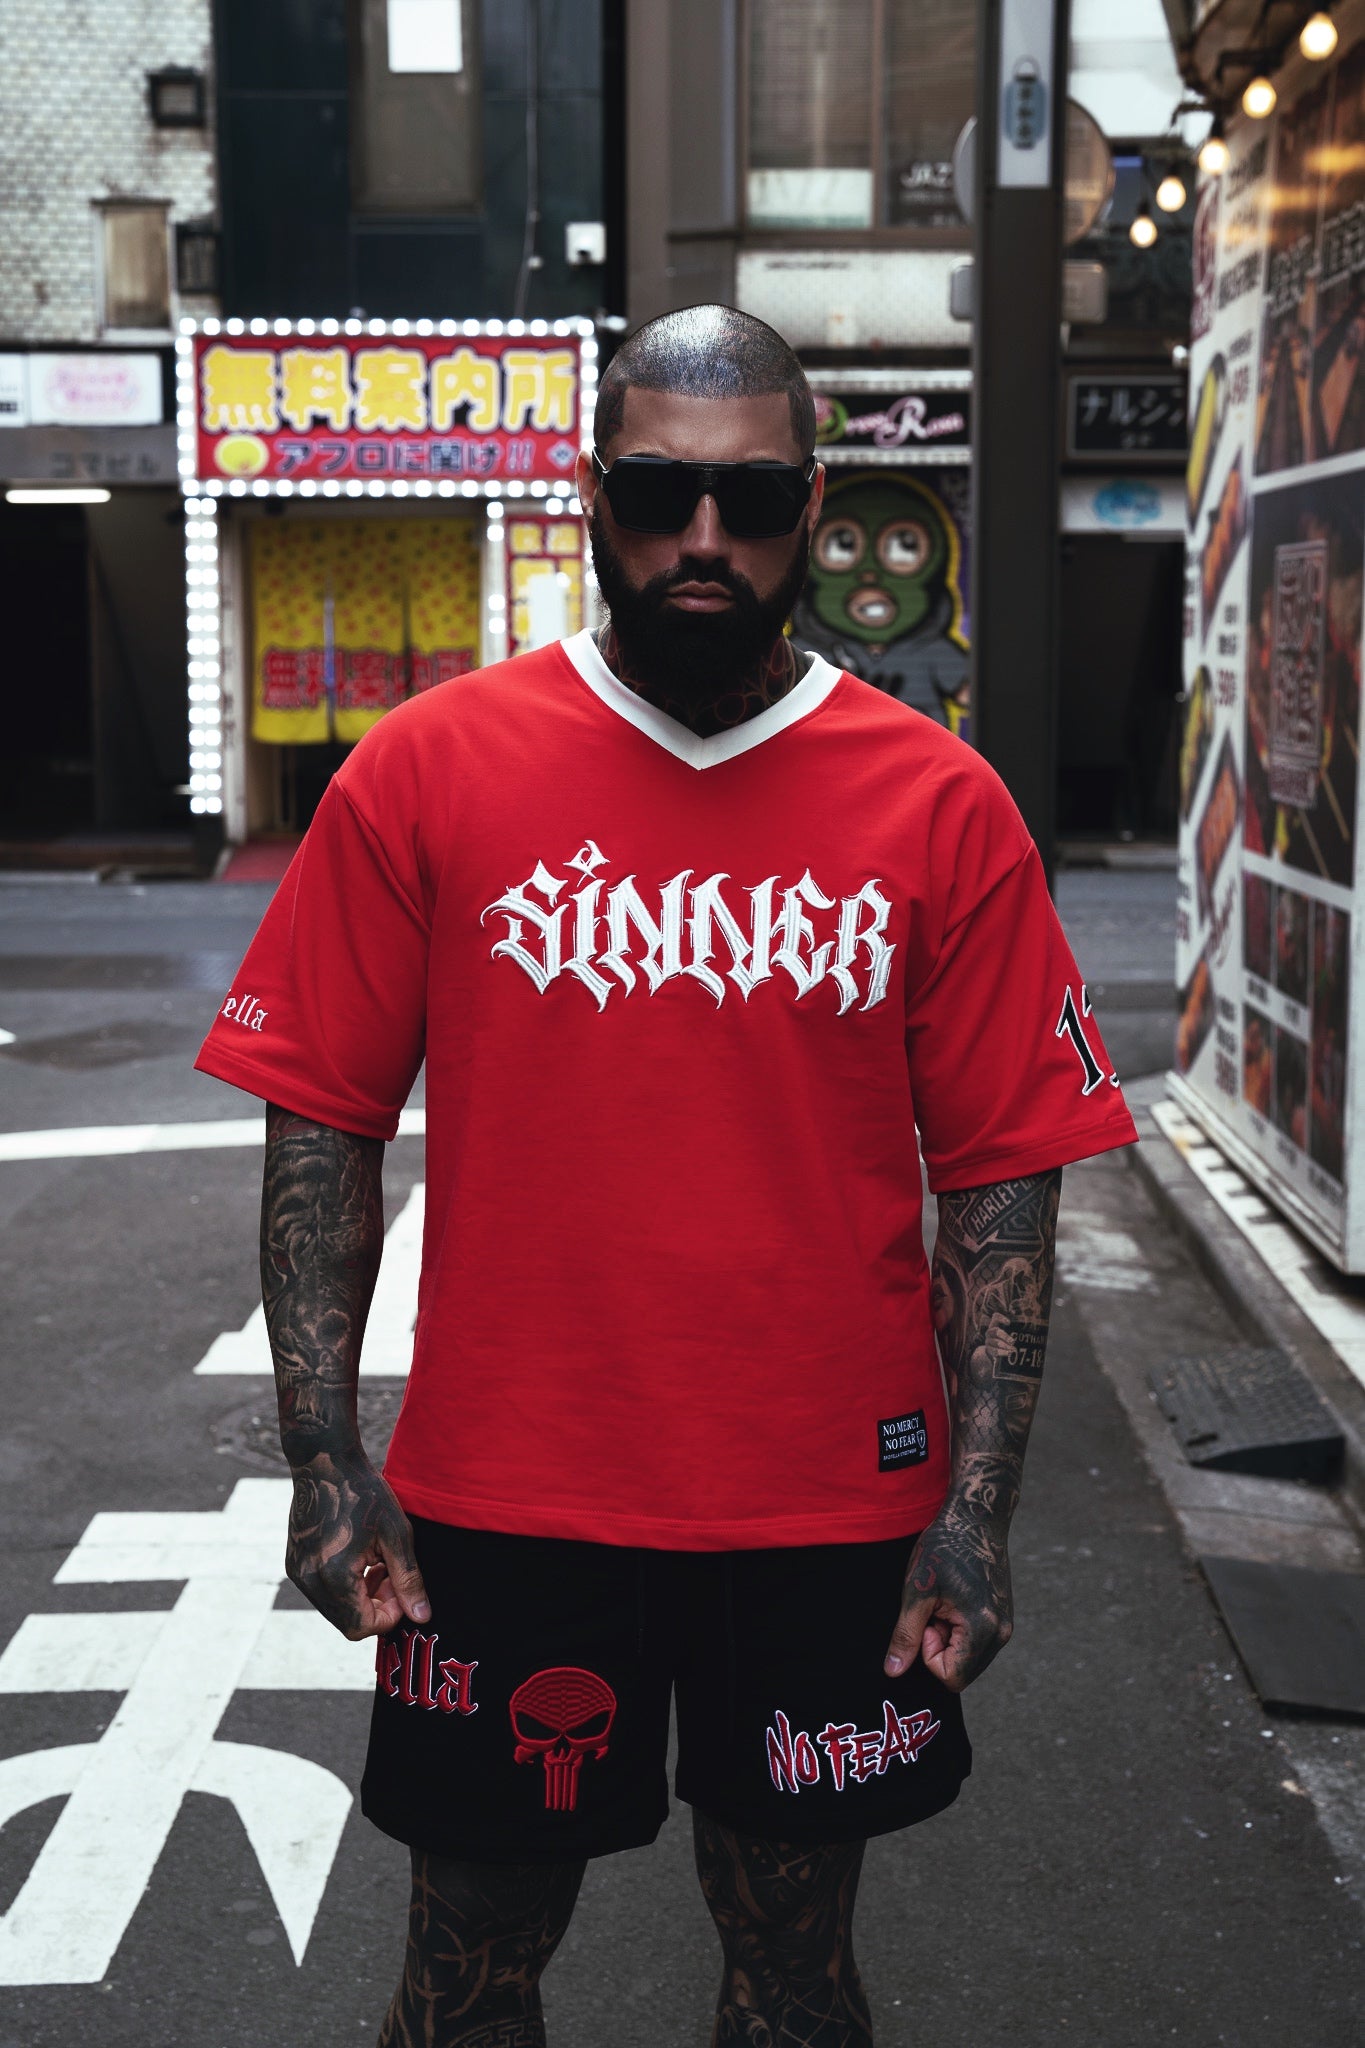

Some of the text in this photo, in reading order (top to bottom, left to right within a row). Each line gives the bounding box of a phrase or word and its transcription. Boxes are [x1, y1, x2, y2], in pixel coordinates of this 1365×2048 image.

[204, 345, 578, 432] 無料案内所
[480, 839, 898, 1017] SINNER
[218, 988, 268, 1031] ella
[883, 1417, 919, 1437] NO MERCY
[885, 1433, 917, 1452] NO FEAR
[767, 1700, 941, 1793] NO FEAR
